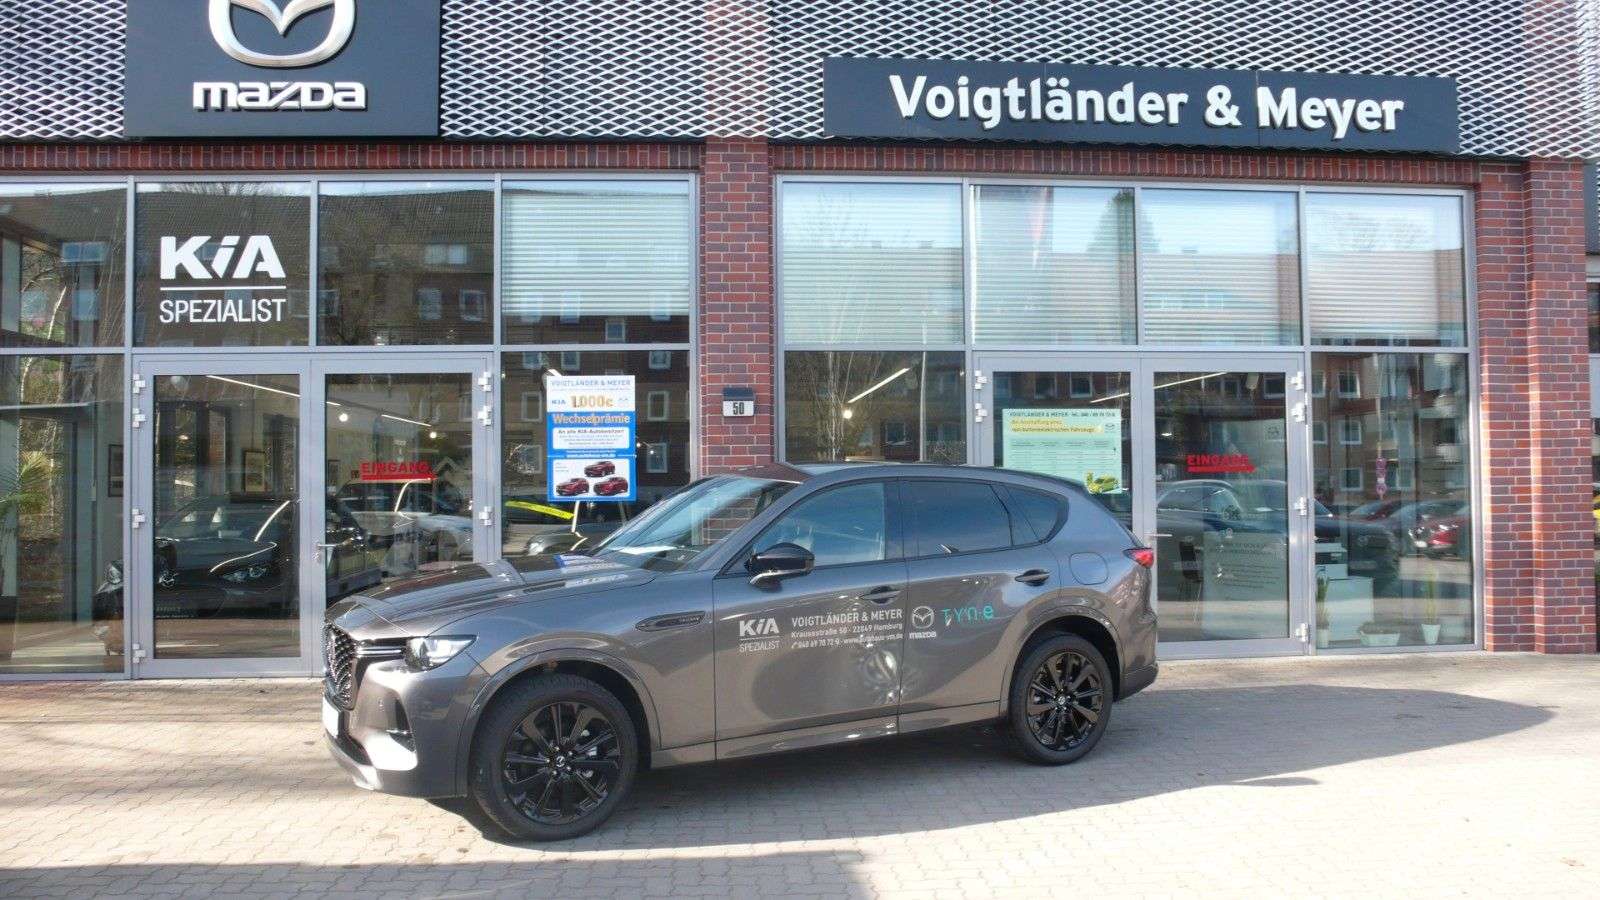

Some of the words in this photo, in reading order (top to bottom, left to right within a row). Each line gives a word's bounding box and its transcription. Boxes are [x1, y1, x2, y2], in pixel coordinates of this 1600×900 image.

[192, 81, 367, 110] mazda
[889, 75, 1189, 130] Voigtländer
[1204, 84, 1243, 127] &
[1256, 86, 1405, 140] Meyer
[159, 298, 286, 323] SPEZIALIST
[732, 401, 745, 415] 50
[553, 412, 631, 425] Wechselprämie
[360, 462, 430, 473] EINGANG
[791, 612, 860, 627] VOIGTLÄNDER
[861, 611, 869, 621] &
[870, 609, 903, 621] MEYER
[873, 622, 903, 632] Hamburg
[739, 640, 781, 652] SPEZIALIST
